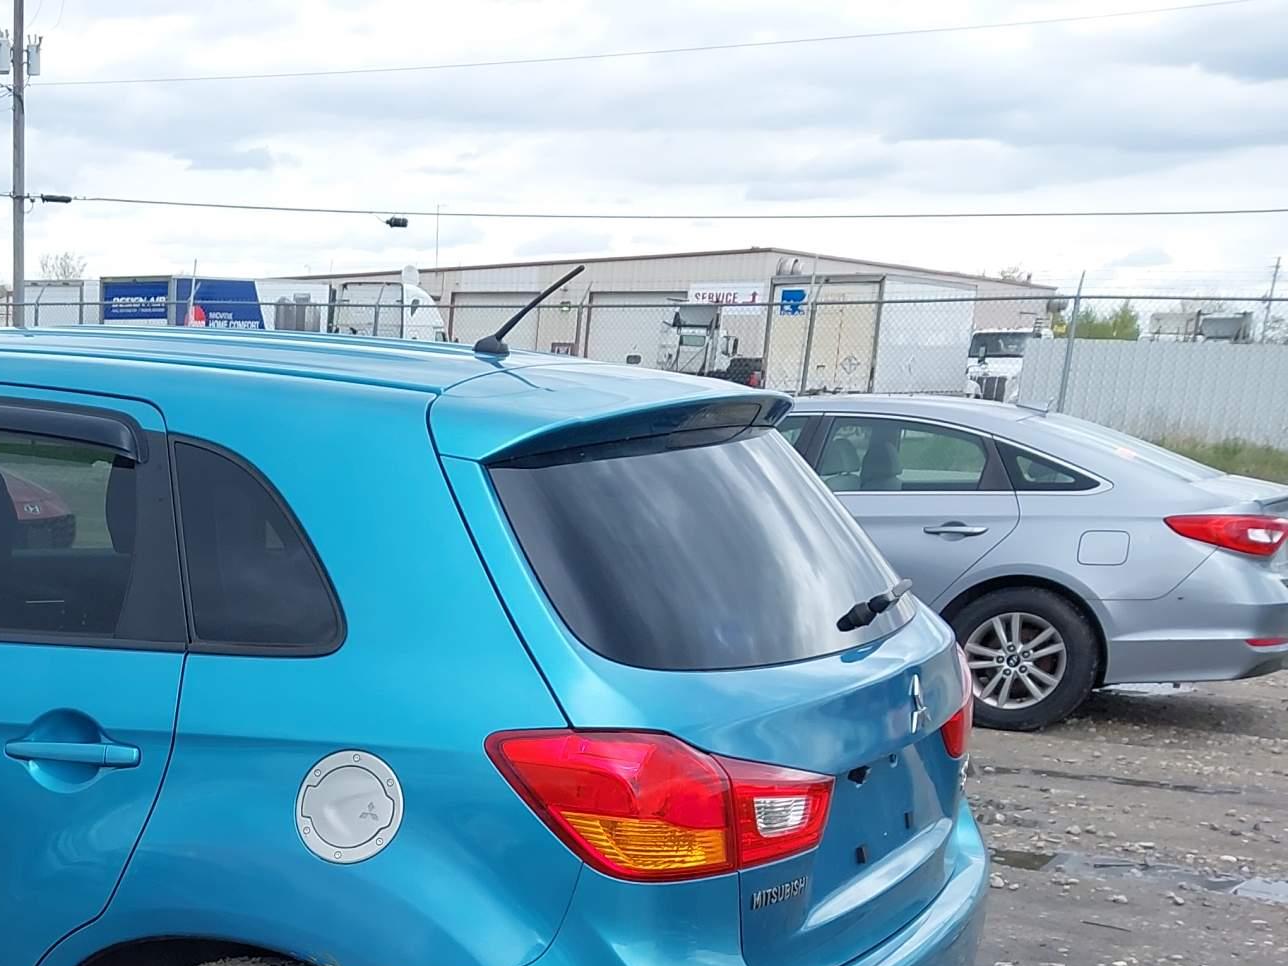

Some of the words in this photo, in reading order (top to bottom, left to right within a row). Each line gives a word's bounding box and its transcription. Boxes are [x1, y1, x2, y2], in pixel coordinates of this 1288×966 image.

[694, 292, 739, 304] SERVICE
[209, 320, 228, 329] HOME
[230, 321, 260, 329] COMFORT
[750, 876, 809, 911] MITSUBISHI
